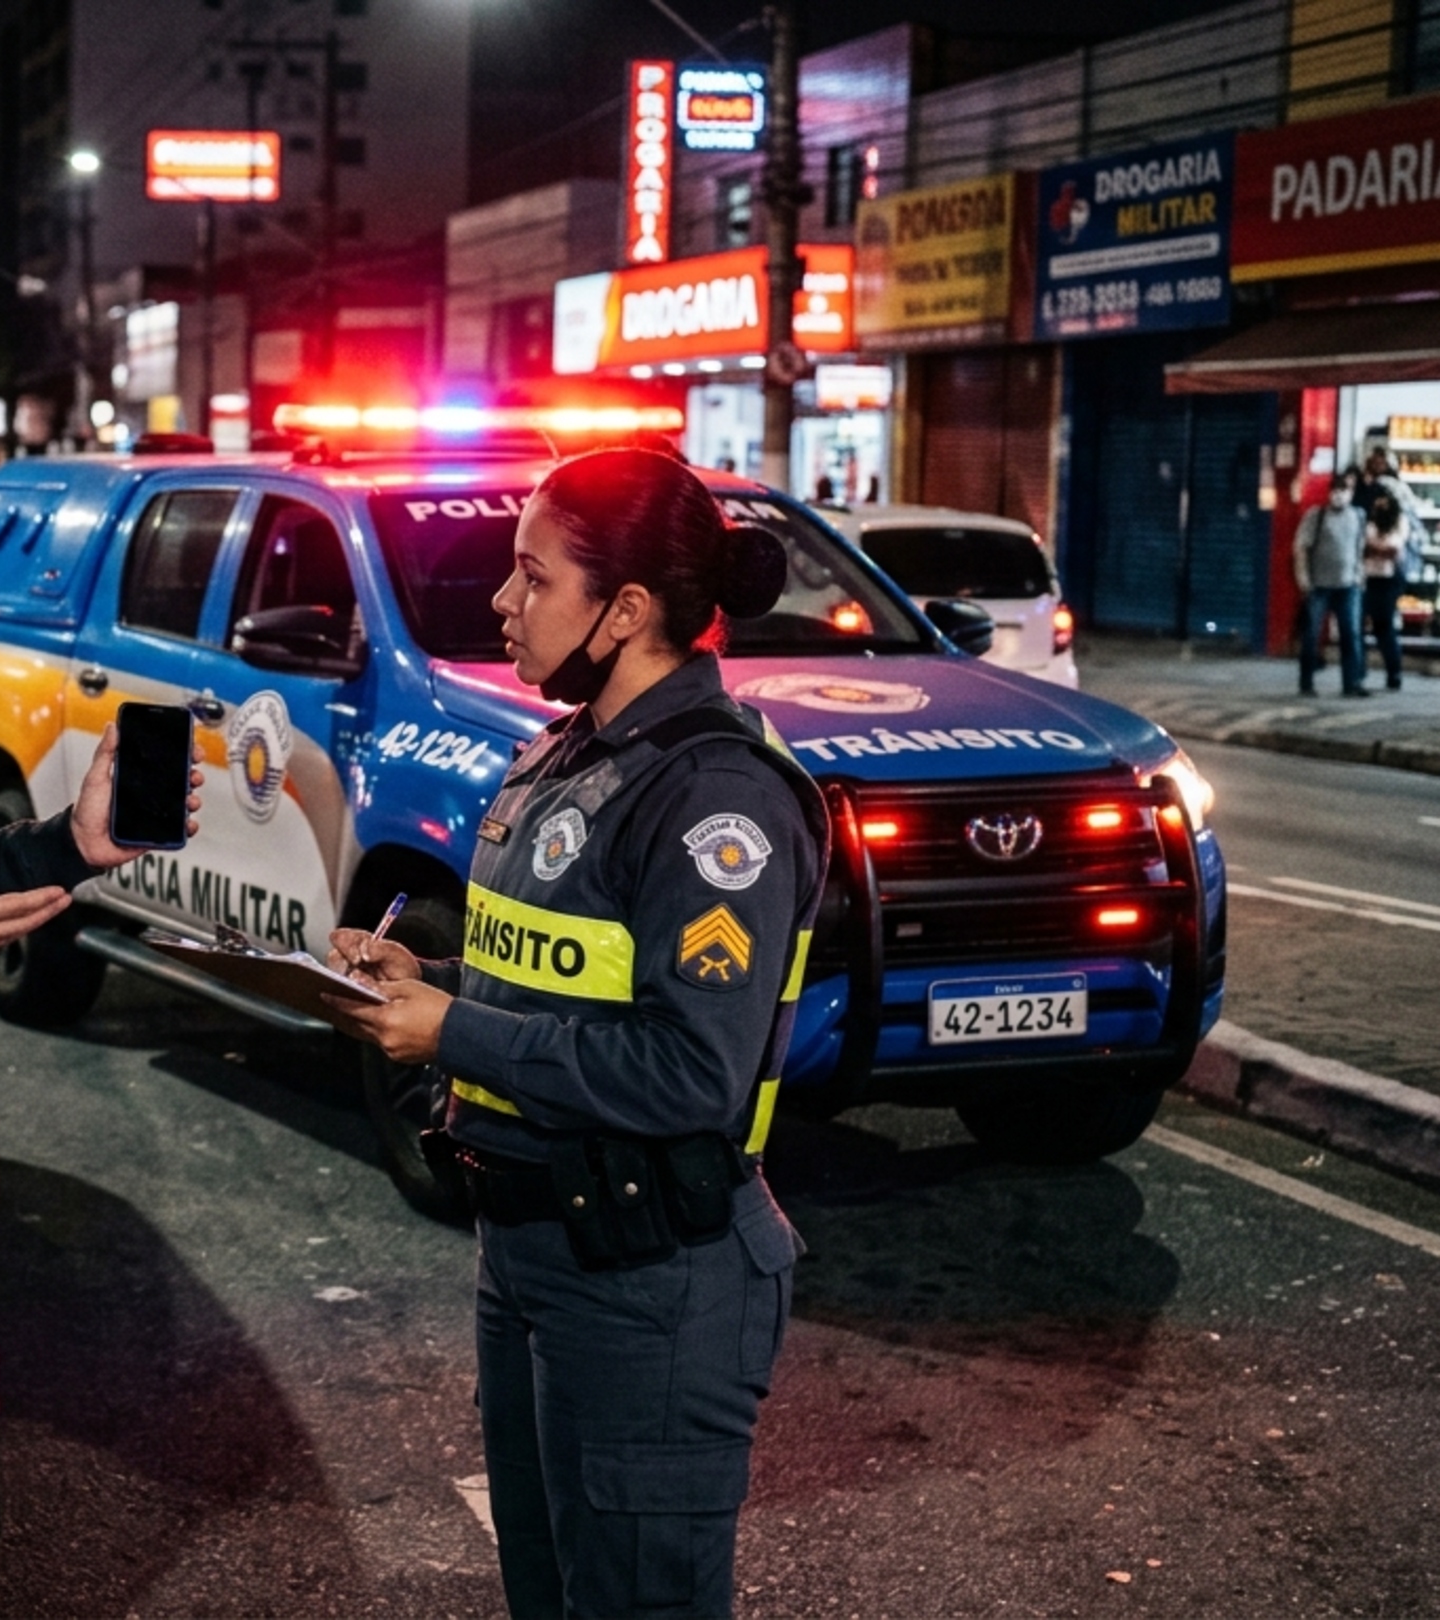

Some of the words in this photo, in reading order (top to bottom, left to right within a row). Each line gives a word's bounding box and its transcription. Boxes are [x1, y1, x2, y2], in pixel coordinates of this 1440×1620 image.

[1095, 150, 1221, 204] DROGARIA
[1117, 192, 1217, 237] MILITAR
[621, 274, 759, 342] DROGARIA
[791, 727, 1085, 761] TRÂNSITO
[191, 866, 308, 953] MILITAR
[944, 997, 1073, 1036] 42-1234
